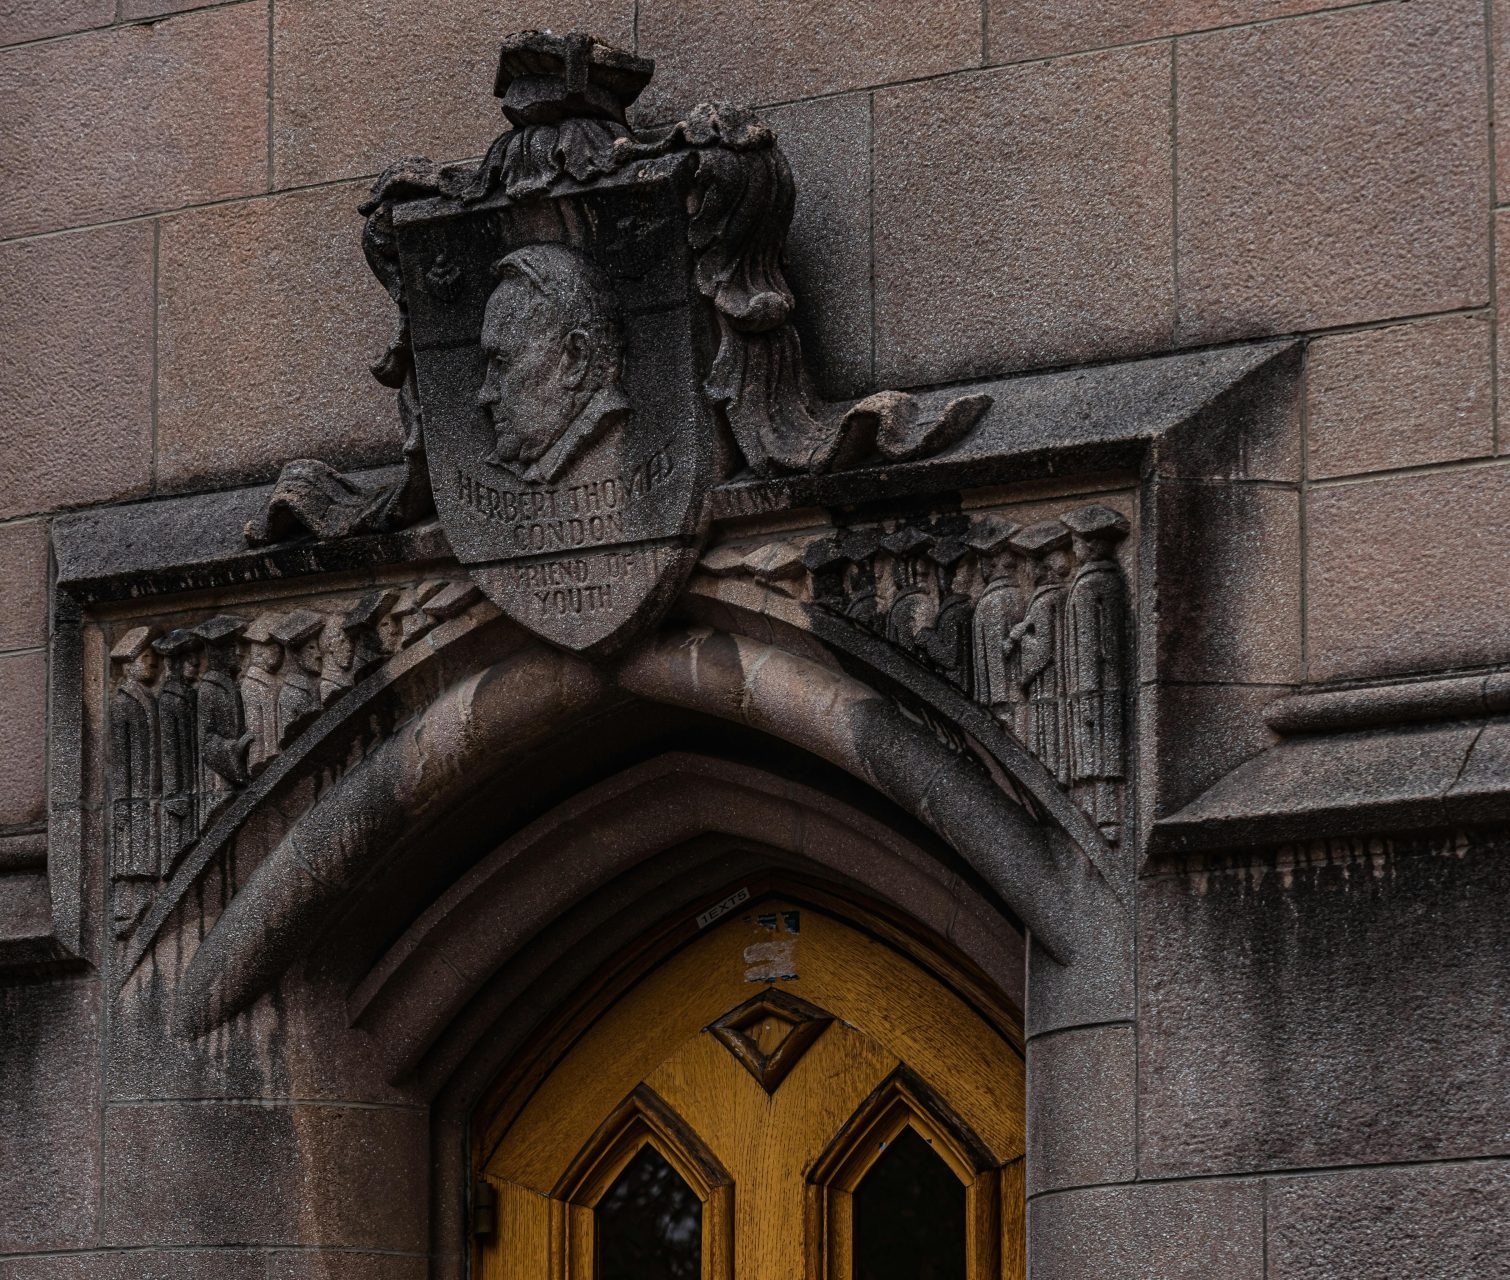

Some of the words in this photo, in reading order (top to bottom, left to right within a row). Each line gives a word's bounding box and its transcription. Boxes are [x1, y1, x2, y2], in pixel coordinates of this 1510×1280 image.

[456, 468, 558, 522] HERBERT
[512, 510, 625, 551] CONDON
[513, 559, 589, 590] FRIEND
[606, 551, 634, 578] OF
[534, 584, 613, 615] YOUTH
